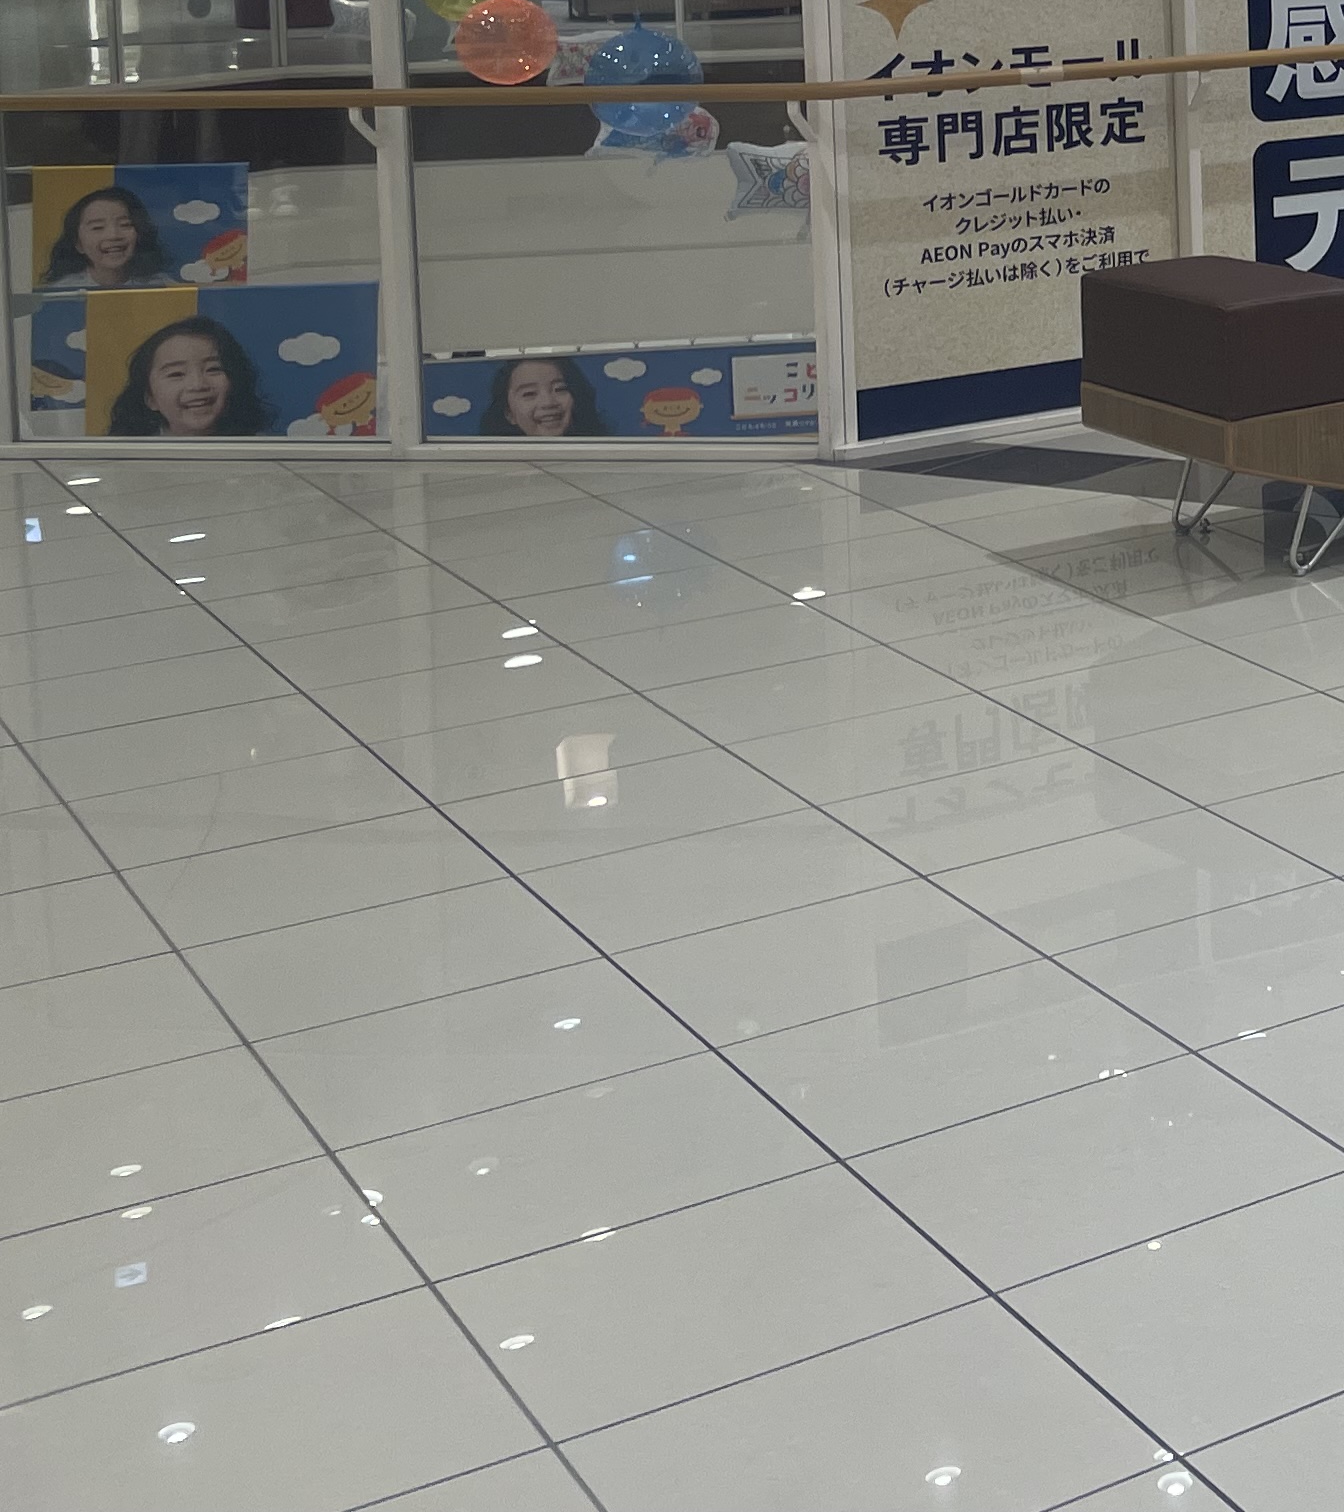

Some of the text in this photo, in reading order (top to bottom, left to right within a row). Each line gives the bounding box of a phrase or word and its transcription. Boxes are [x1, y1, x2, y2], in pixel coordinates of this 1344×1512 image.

[877, 96, 1146, 166] 専門店限定
[922, 178, 1111, 213] イオンゴールドカードの
[920, 226, 1116, 265] AEON Payのスマホ決済
